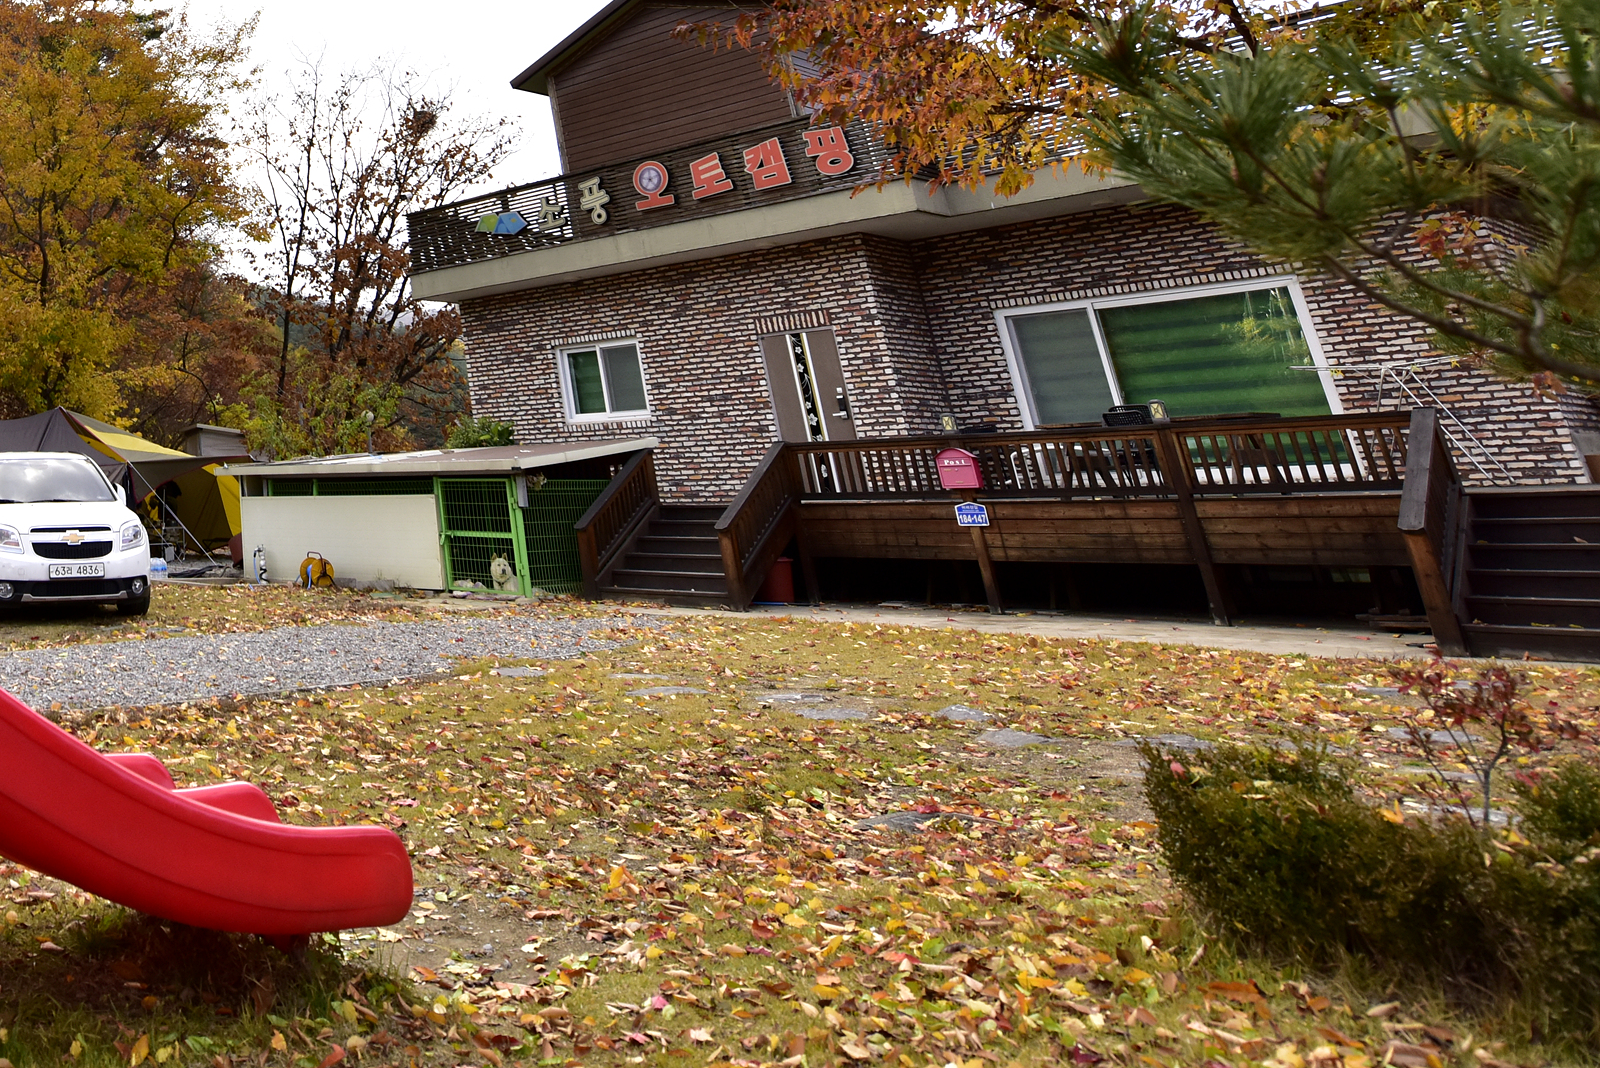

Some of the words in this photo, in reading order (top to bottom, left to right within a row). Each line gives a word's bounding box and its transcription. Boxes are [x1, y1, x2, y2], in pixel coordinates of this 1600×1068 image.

[537, 176, 611, 231] 소풍
[632, 126, 855, 212] 오토캠핑
[959, 514, 986, 523] 184-147
[76, 565, 100, 575] 4836
